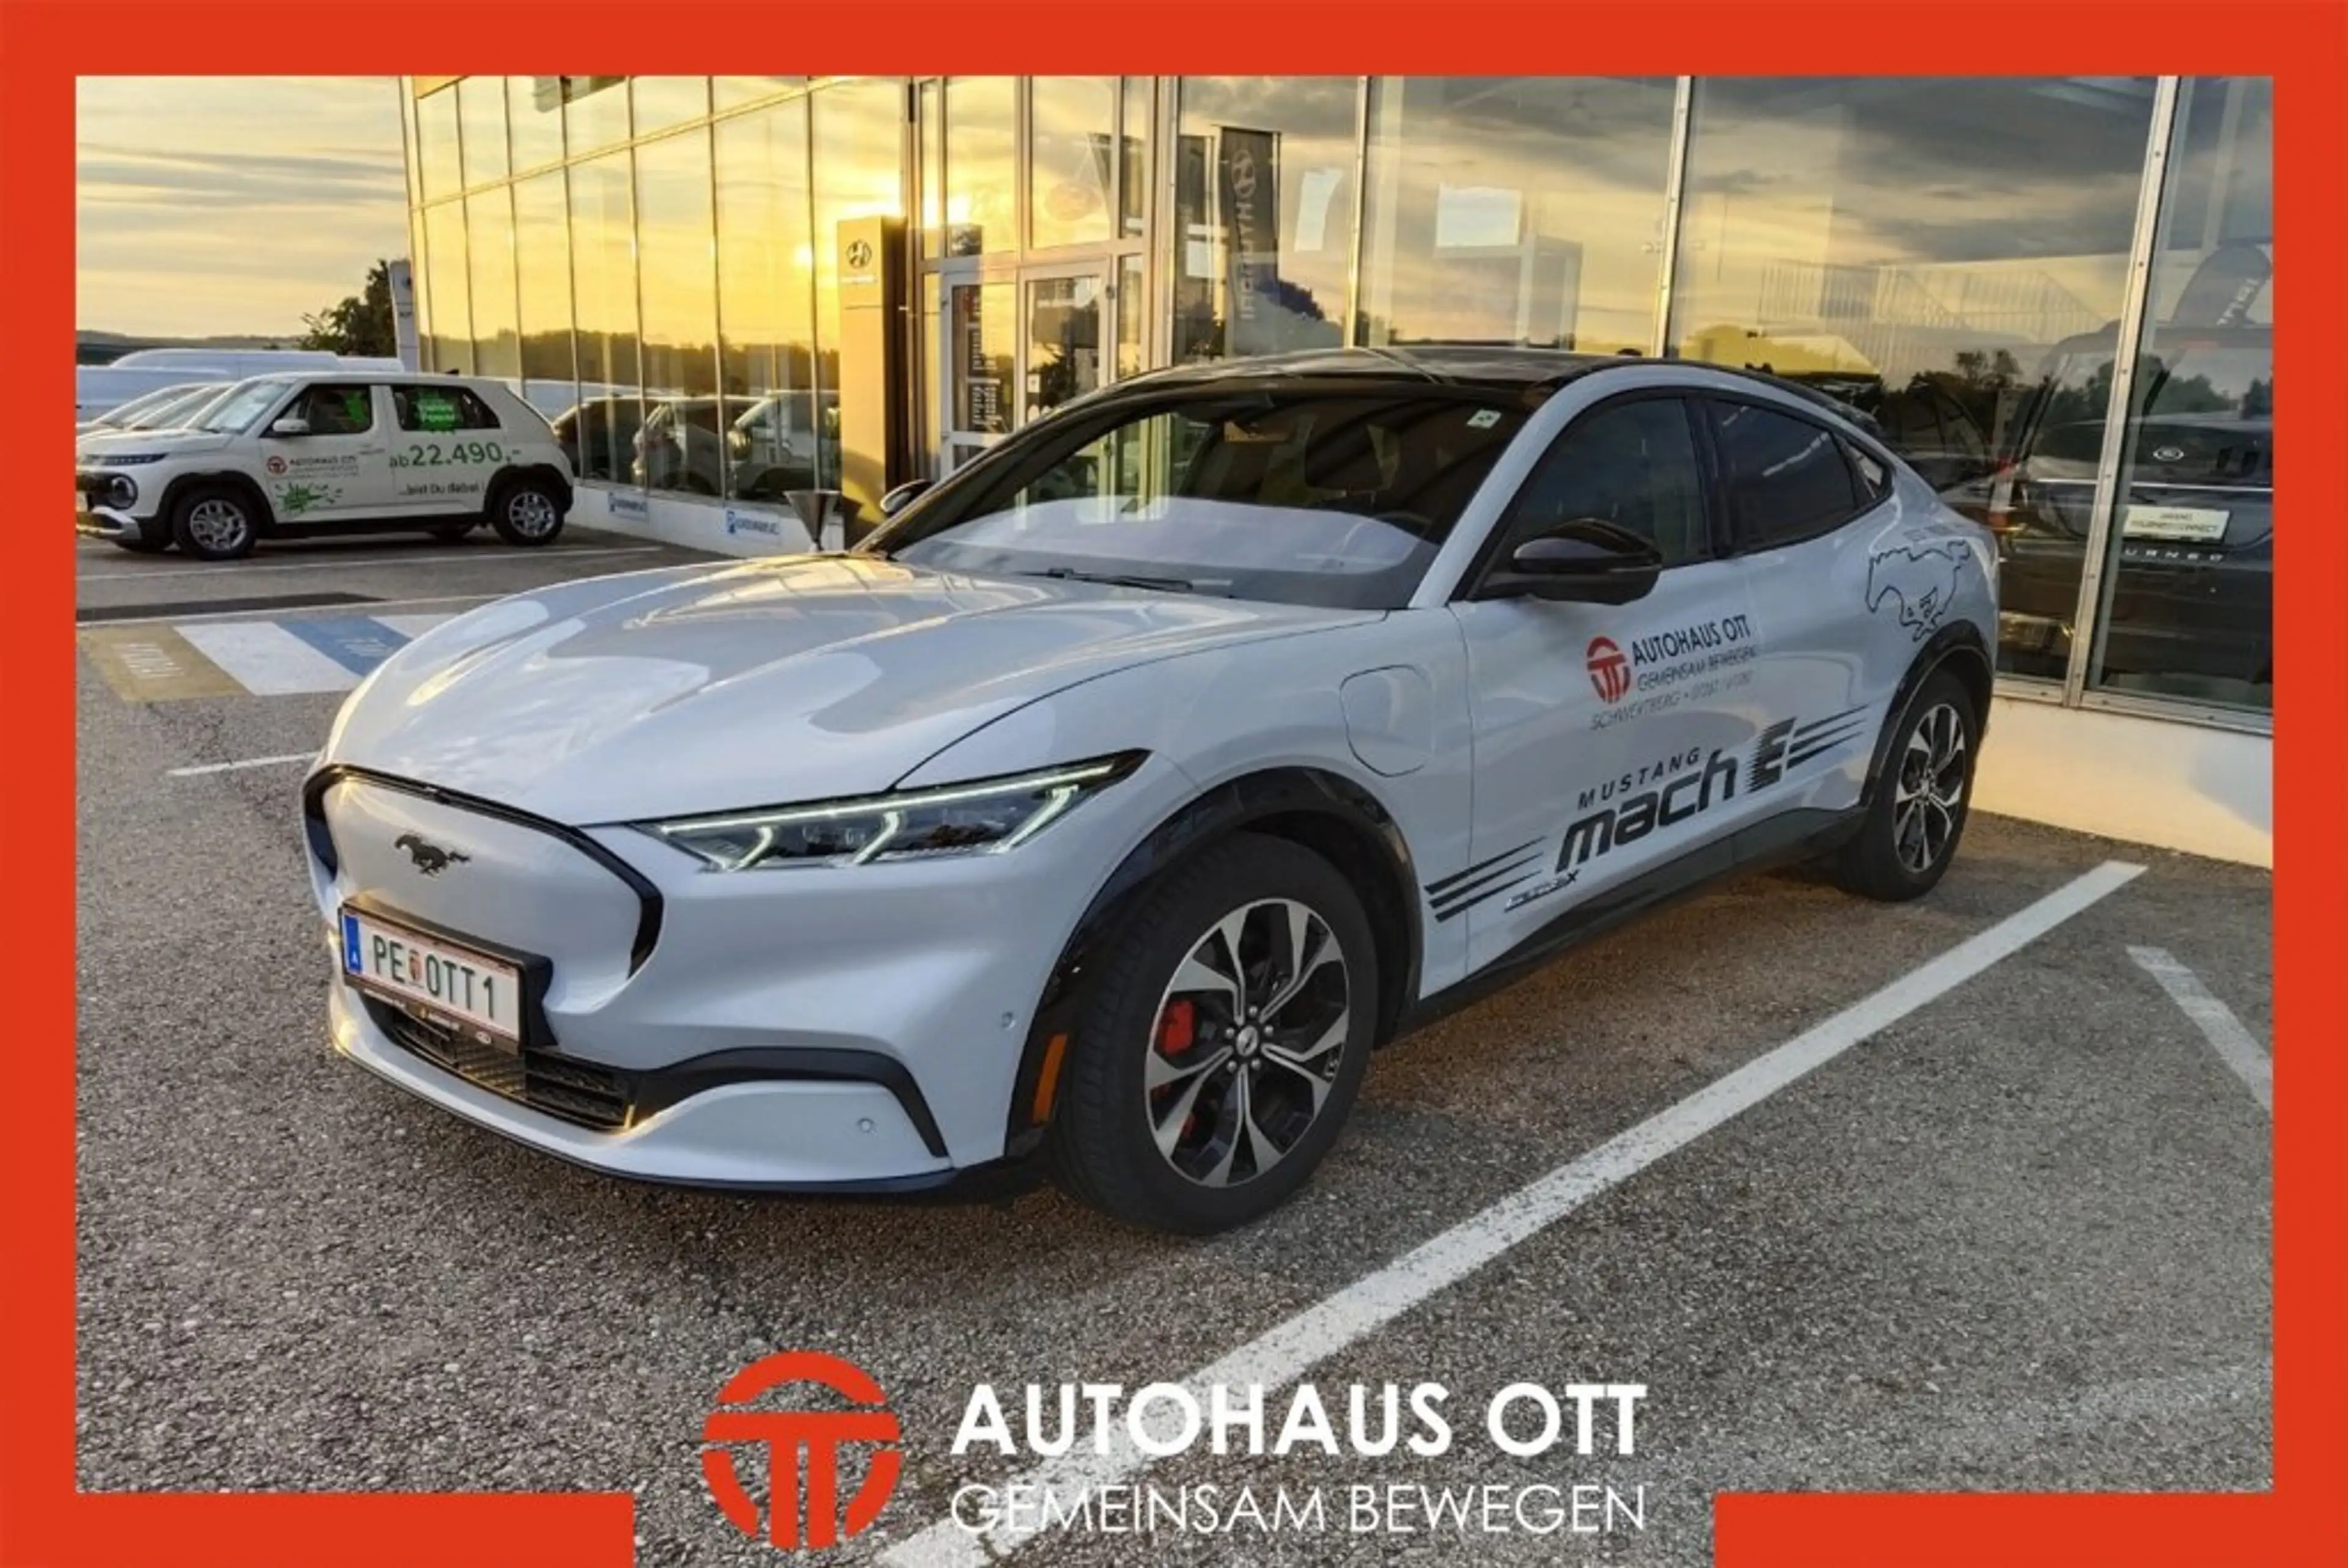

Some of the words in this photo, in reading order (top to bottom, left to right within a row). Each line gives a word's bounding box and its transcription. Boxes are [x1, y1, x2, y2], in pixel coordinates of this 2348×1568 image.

[1632, 622, 1722, 666] AUTOHAUS
[1722, 614, 1751, 642] OTT
[1578, 747, 1701, 810] MUSTANG
[1555, 748, 1738, 874] mach
[373, 935, 405, 984] PE
